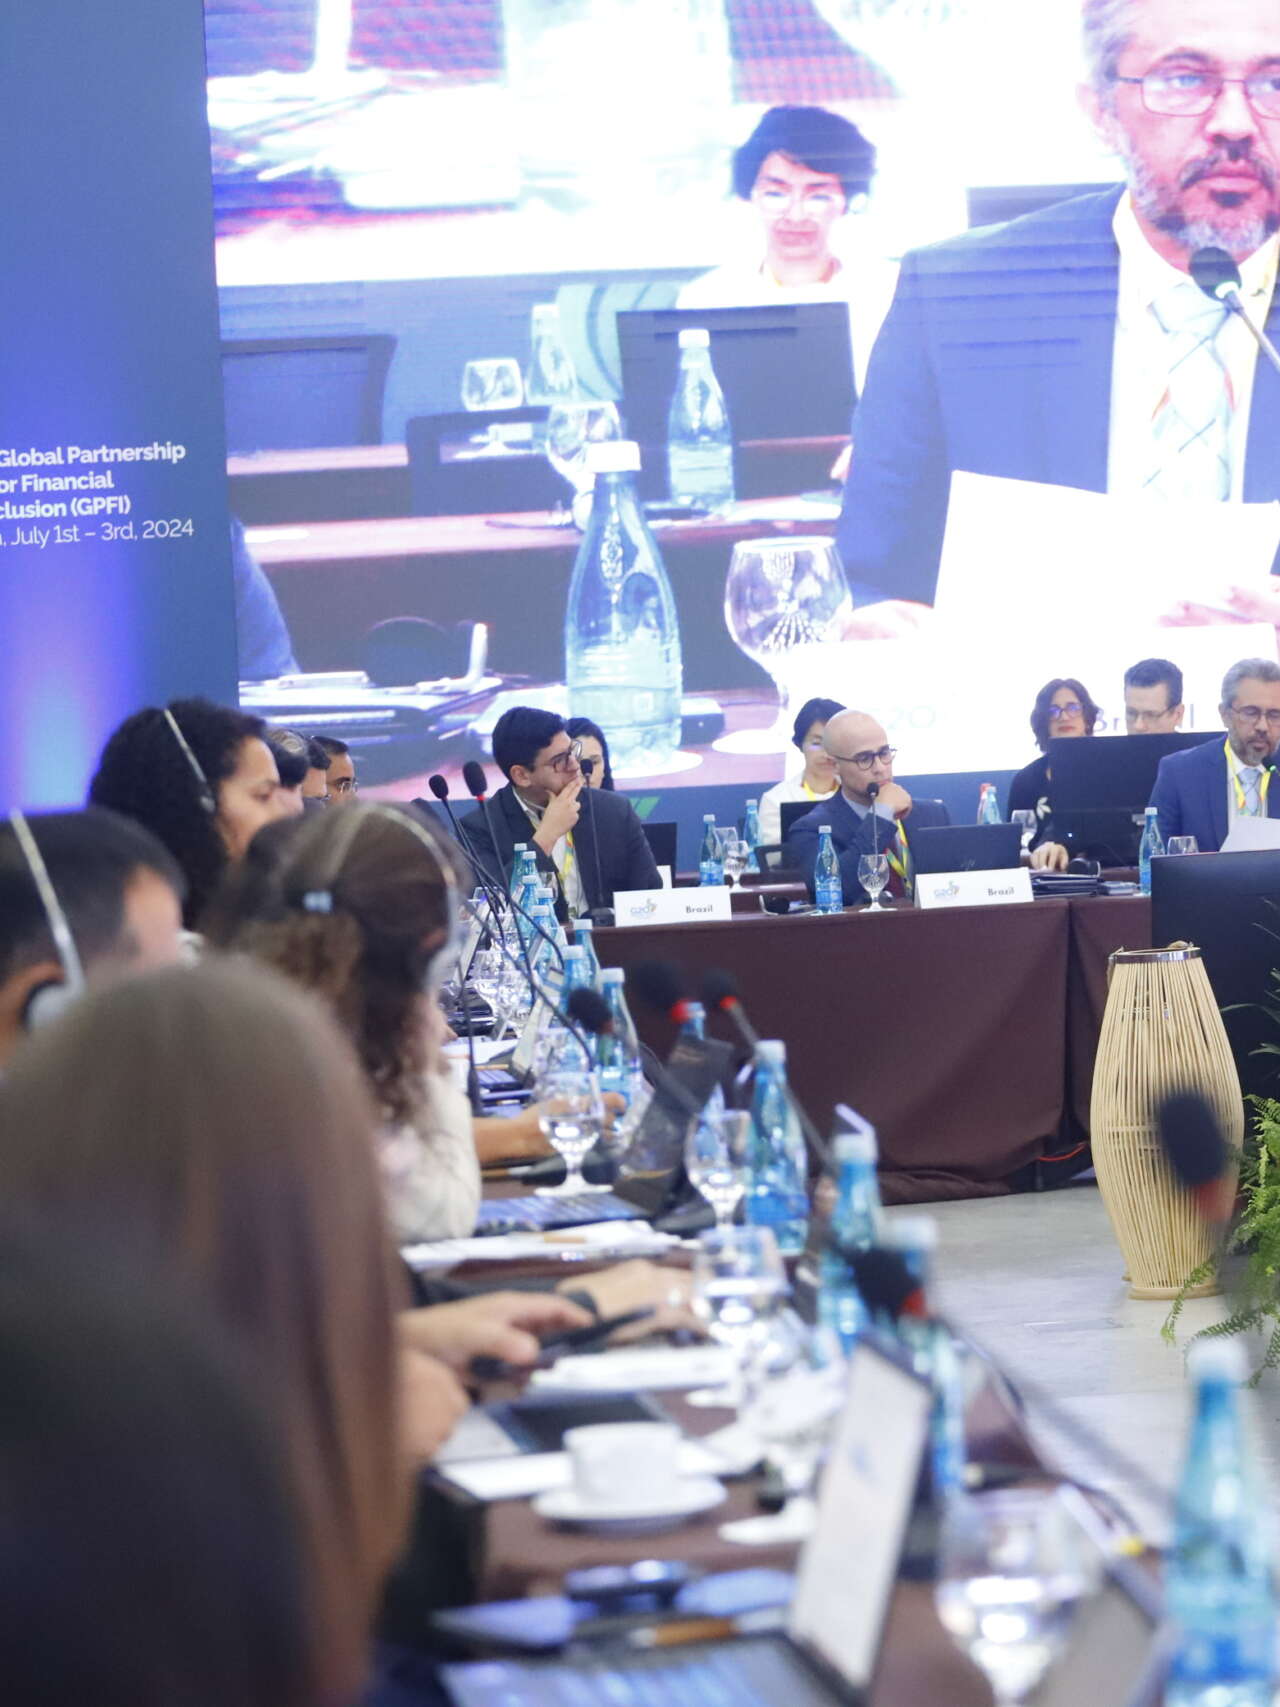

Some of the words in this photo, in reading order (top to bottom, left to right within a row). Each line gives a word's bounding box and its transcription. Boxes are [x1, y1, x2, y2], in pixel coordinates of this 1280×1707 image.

[0, 446, 64, 467] Global
[68, 441, 186, 464] Partnership
[21, 470, 114, 492] Financial
[70, 495, 131, 518] (GPFI)
[11, 526, 50, 549] July
[53, 524, 80, 543] 1st
[101, 520, 138, 542] 3rd,
[142, 519, 194, 539] 2024
[987, 886, 1015, 897] Brazil
[686, 904, 713, 914] Brazil
